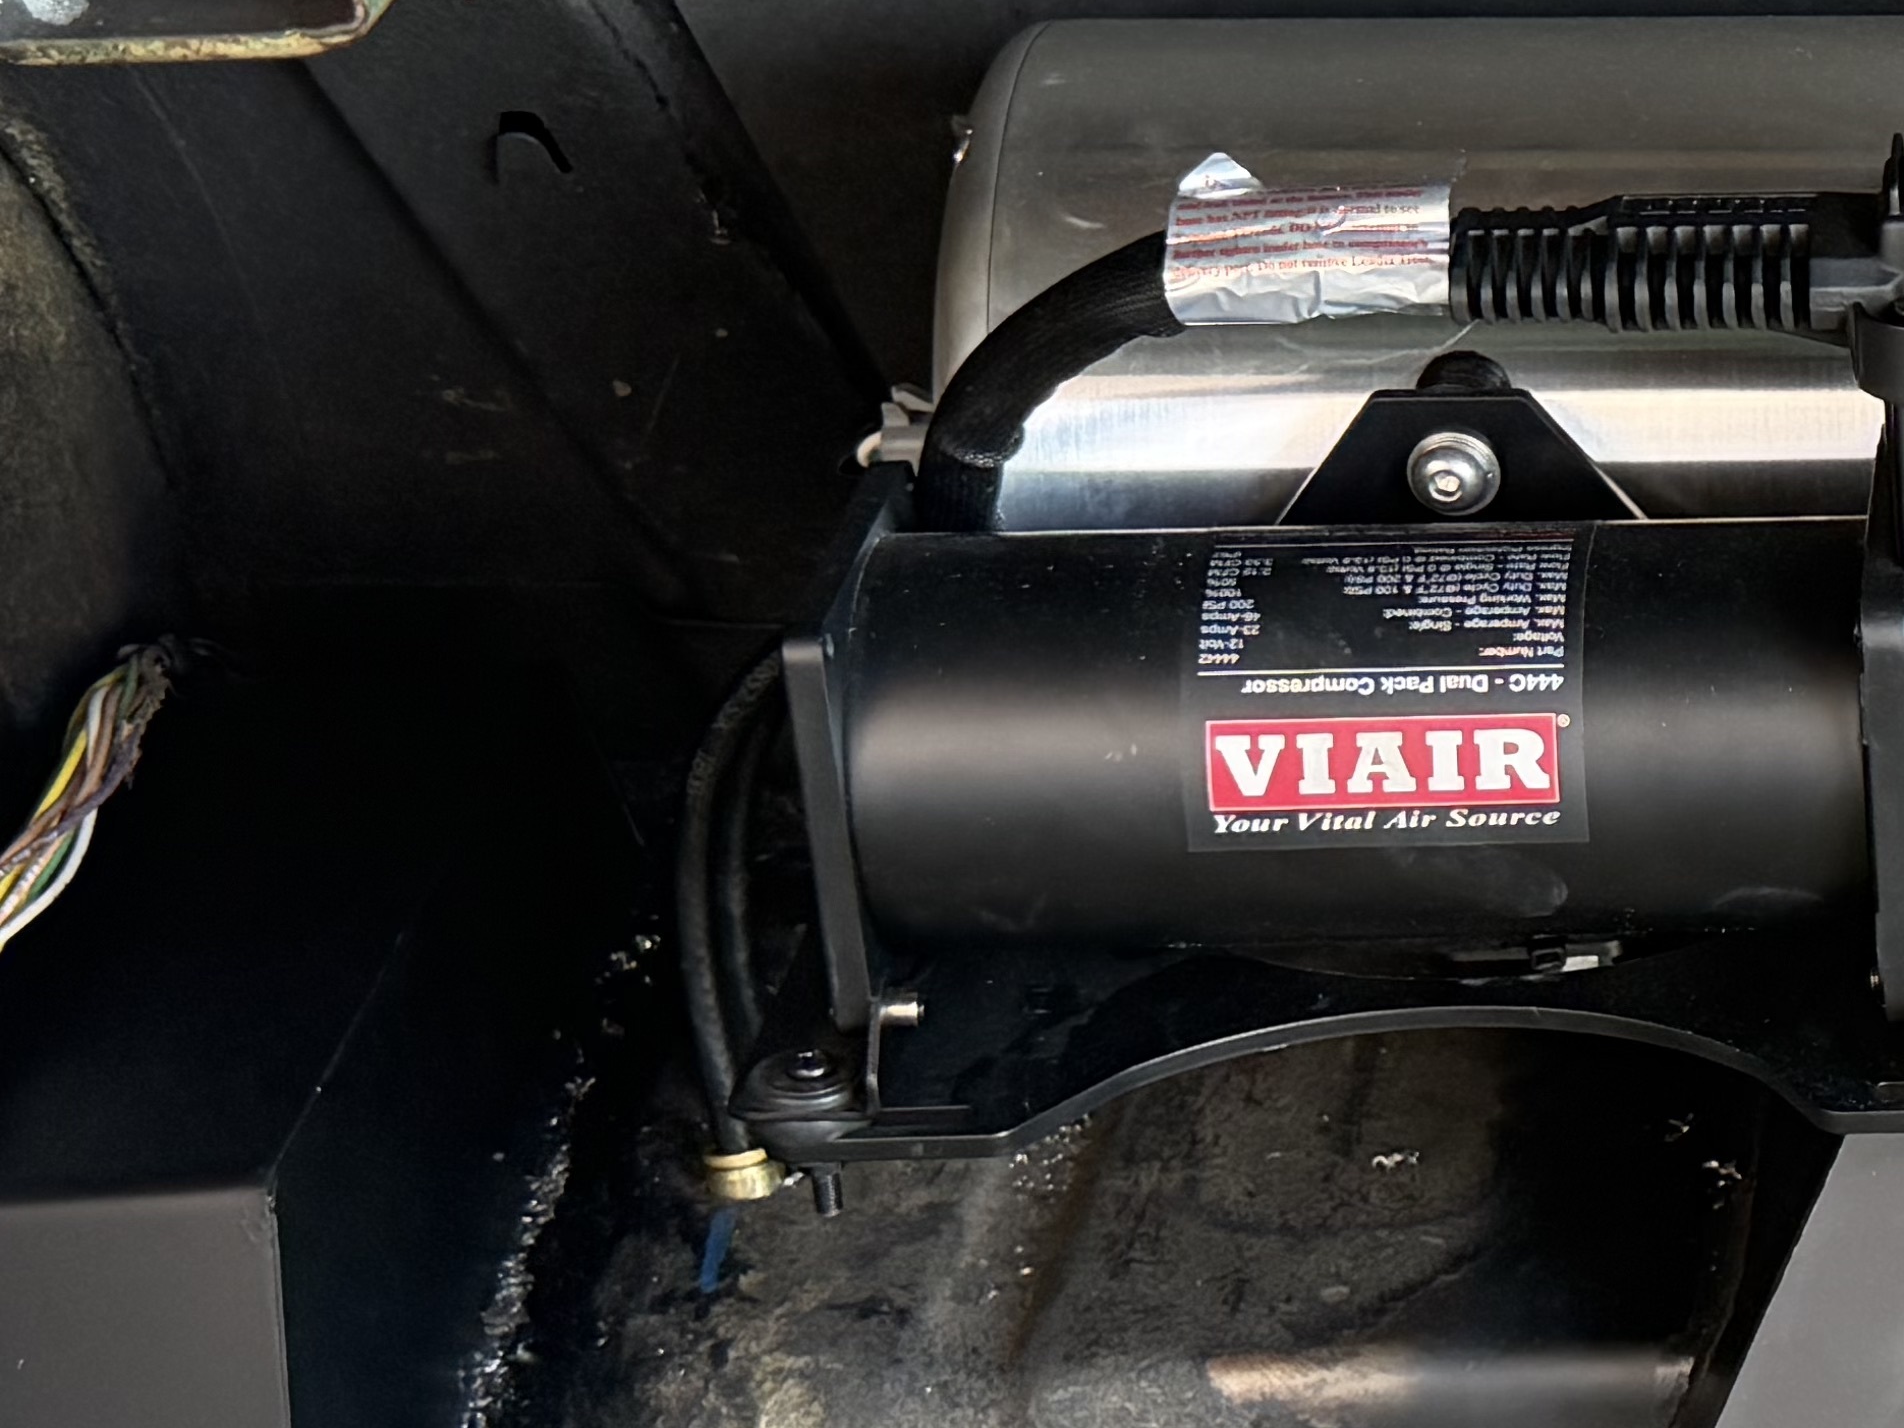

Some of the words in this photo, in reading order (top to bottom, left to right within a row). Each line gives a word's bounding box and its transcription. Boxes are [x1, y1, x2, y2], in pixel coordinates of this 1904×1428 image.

[1464, 570, 1501, 581] Cycle
[1504, 571, 1534, 580] Duty
[1375, 586, 1398, 594] 100
[1463, 582, 1499, 593] Cycle
[1502, 582, 1532, 592] Duty
[1536, 582, 1567, 592] Max.
[1480, 592, 1532, 604] Working
[1535, 594, 1566, 603] Max.
[1229, 599, 1254, 609] 200
[1465, 605, 1530, 616] Amperage
[1535, 605, 1565, 615] Max.
[1408, 619, 1453, 631] Single:
[1464, 618, 1530, 629] Amperage
[1534, 618, 1564, 629] Max.
[1513, 631, 1564, 642] Voltage:
[1199, 639, 1244, 649] 12-Volt
[1478, 647, 1534, 657] Number:
[1537, 646, 1564, 657] Part
[1241, 674, 1375, 696] Compressor
[1381, 675, 1434, 695] Pack
[1440, 673, 1488, 693] Dual
[1509, 673, 1565, 692] 444C
[1215, 728, 1551, 798] VIAIR
[1212, 814, 1288, 835] Your
[1299, 810, 1374, 832] Vital
[1384, 810, 1437, 829] Air
[1446, 808, 1562, 828] Source
